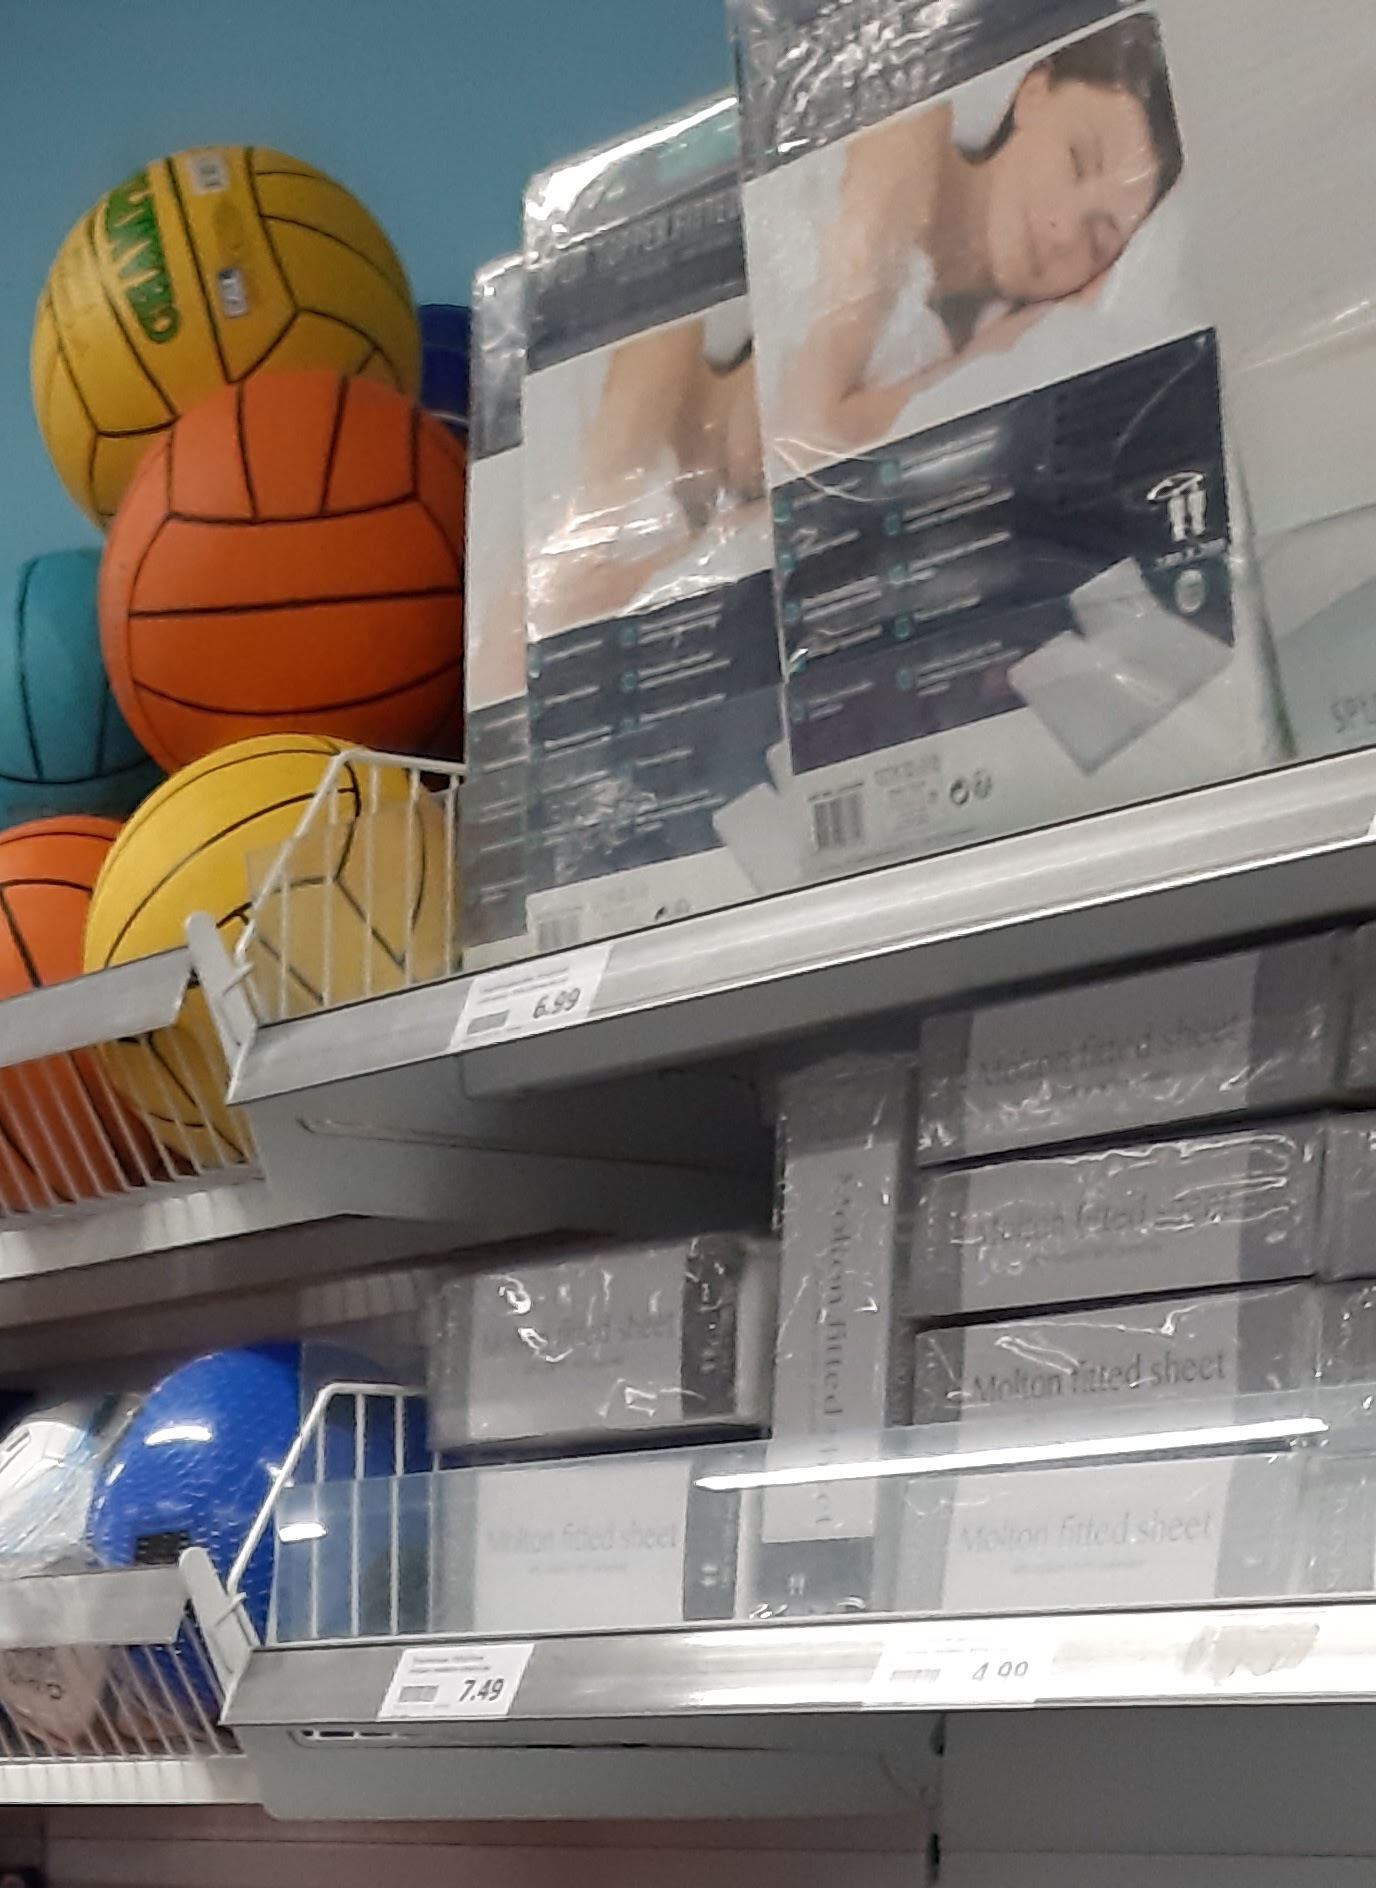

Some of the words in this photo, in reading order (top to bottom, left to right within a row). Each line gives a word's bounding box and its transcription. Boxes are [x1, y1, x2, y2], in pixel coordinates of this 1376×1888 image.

[532, 986, 582, 1019] 6.99
[824, 1319, 847, 1415] fitted
[973, 1367, 1063, 1401] Molton
[1071, 1353, 1141, 1393] fitted
[1150, 1350, 1226, 1386] sheet
[562, 1522, 613, 1551] fitted
[620, 1519, 678, 1549] sheet
[961, 1520, 1048, 1552] Molton
[1059, 1512, 1131, 1547] fitted
[1138, 1507, 1212, 1543] sheet
[458, 1677, 505, 1703] 7.49
